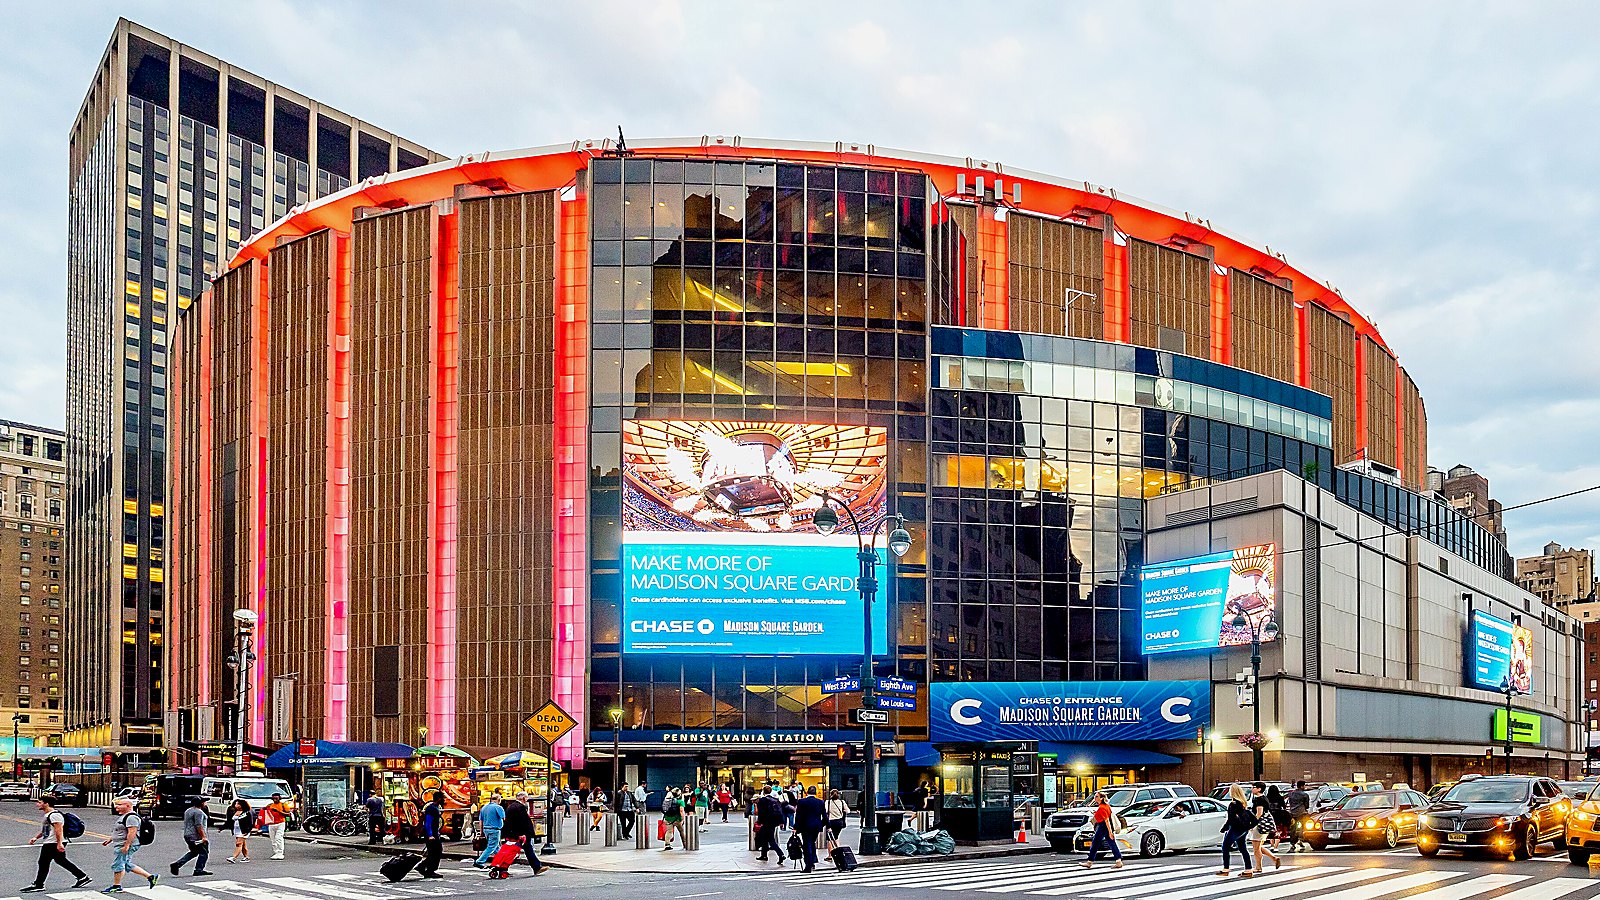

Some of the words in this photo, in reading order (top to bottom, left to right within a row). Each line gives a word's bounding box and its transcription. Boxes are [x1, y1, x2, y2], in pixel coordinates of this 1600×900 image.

[631, 555, 682, 571] MAKE
[687, 555, 742, 571] MORE
[746, 555, 773, 572] OF
[631, 574, 718, 590] MADISON
[723, 574, 798, 593] SQUARE
[1145, 590, 1161, 598] MAKE
[1162, 587, 1179, 595] MORE
[1180, 585, 1189, 593] OF
[1145, 595, 1172, 604] MADISON
[1173, 592, 1197, 601] SQUARE
[1197, 587, 1223, 597] GARDEN
[631, 620, 695, 633] CHASE
[724, 620, 760, 632] MADISON
[761, 620, 791, 633] SQUARE
[1145, 630, 1172, 641] CHASE
[824, 683, 839, 691] West
[839, 680, 851, 689] 33rd
[851, 680, 858, 688] St
[880, 680, 901, 690] Eighth
[901, 682, 914, 691] Ave
[880, 699, 890, 707] Joe
[890, 700, 904, 708] Louis
[1019, 697, 1051, 705] CHASE
[1064, 696, 1123, 704] ENTRANCE
[536, 714, 564, 723] DEAD
[1000, 706, 1049, 722] MADISON
[1053, 706, 1095, 722] SQUARE
[540, 724, 560, 733] END
[663, 733, 765, 742] PENNSYLVANIA
[770, 733, 824, 742] STATION
[386, 759, 395, 768] HOT
[396, 759, 406, 768] DOG
